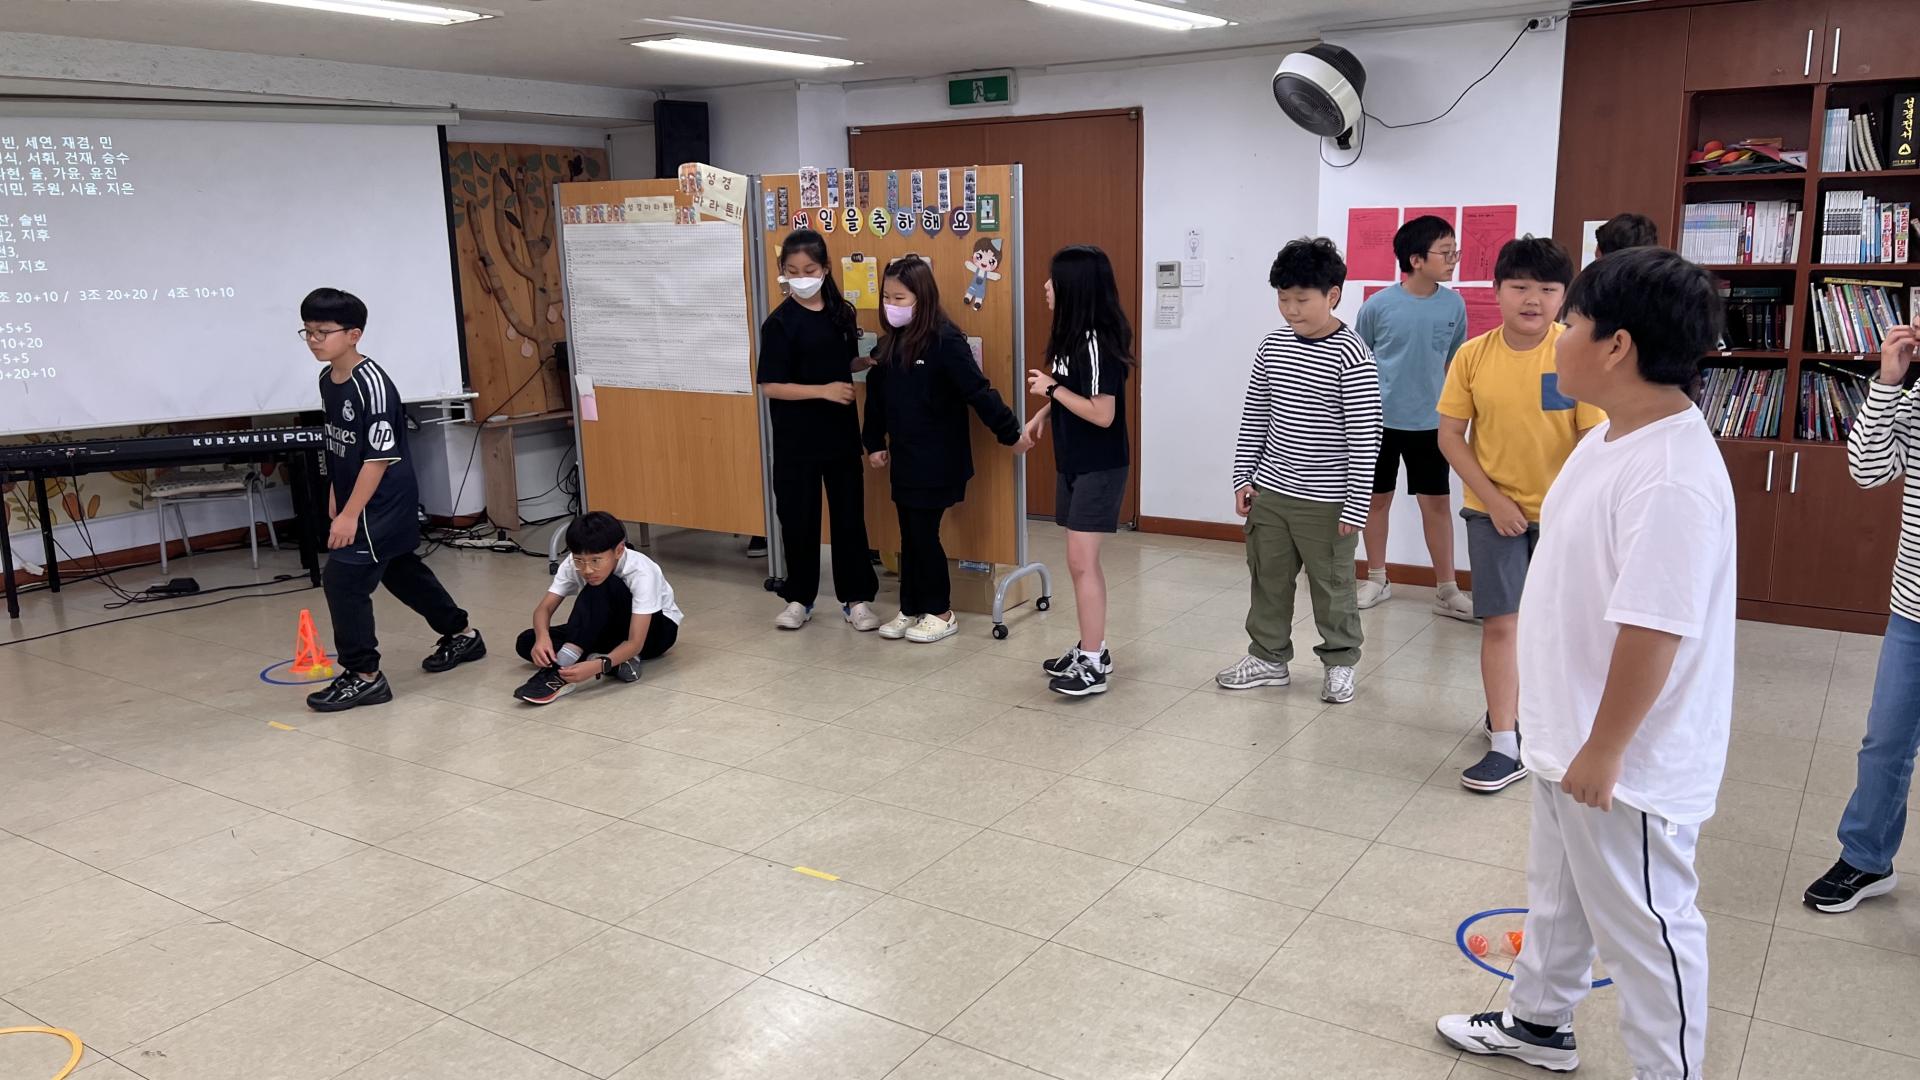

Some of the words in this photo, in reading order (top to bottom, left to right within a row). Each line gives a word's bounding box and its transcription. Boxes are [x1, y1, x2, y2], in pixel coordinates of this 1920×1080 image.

[25, 136, 57, 150] 세연,
[99, 136, 113, 150] 민
[0, 151, 22, 166] 식,
[101, 151, 130, 166] 승수
[53, 167, 85, 181] 가윤,
[89, 167, 117, 180] 윤진
[32, 182, 64, 196] 주원,
[107, 182, 135, 196] 지은
[21, 229, 50, 242] 지후
[19, 260, 48, 273] 지호
[16, 291, 58, 303] 20+10
[79, 289, 102, 301] 3조
[106, 289, 148, 301] 20+20
[167, 287, 190, 300] 4조
[195, 287, 235, 298] 10+10
[192, 434, 278, 447] KURZWEIL
